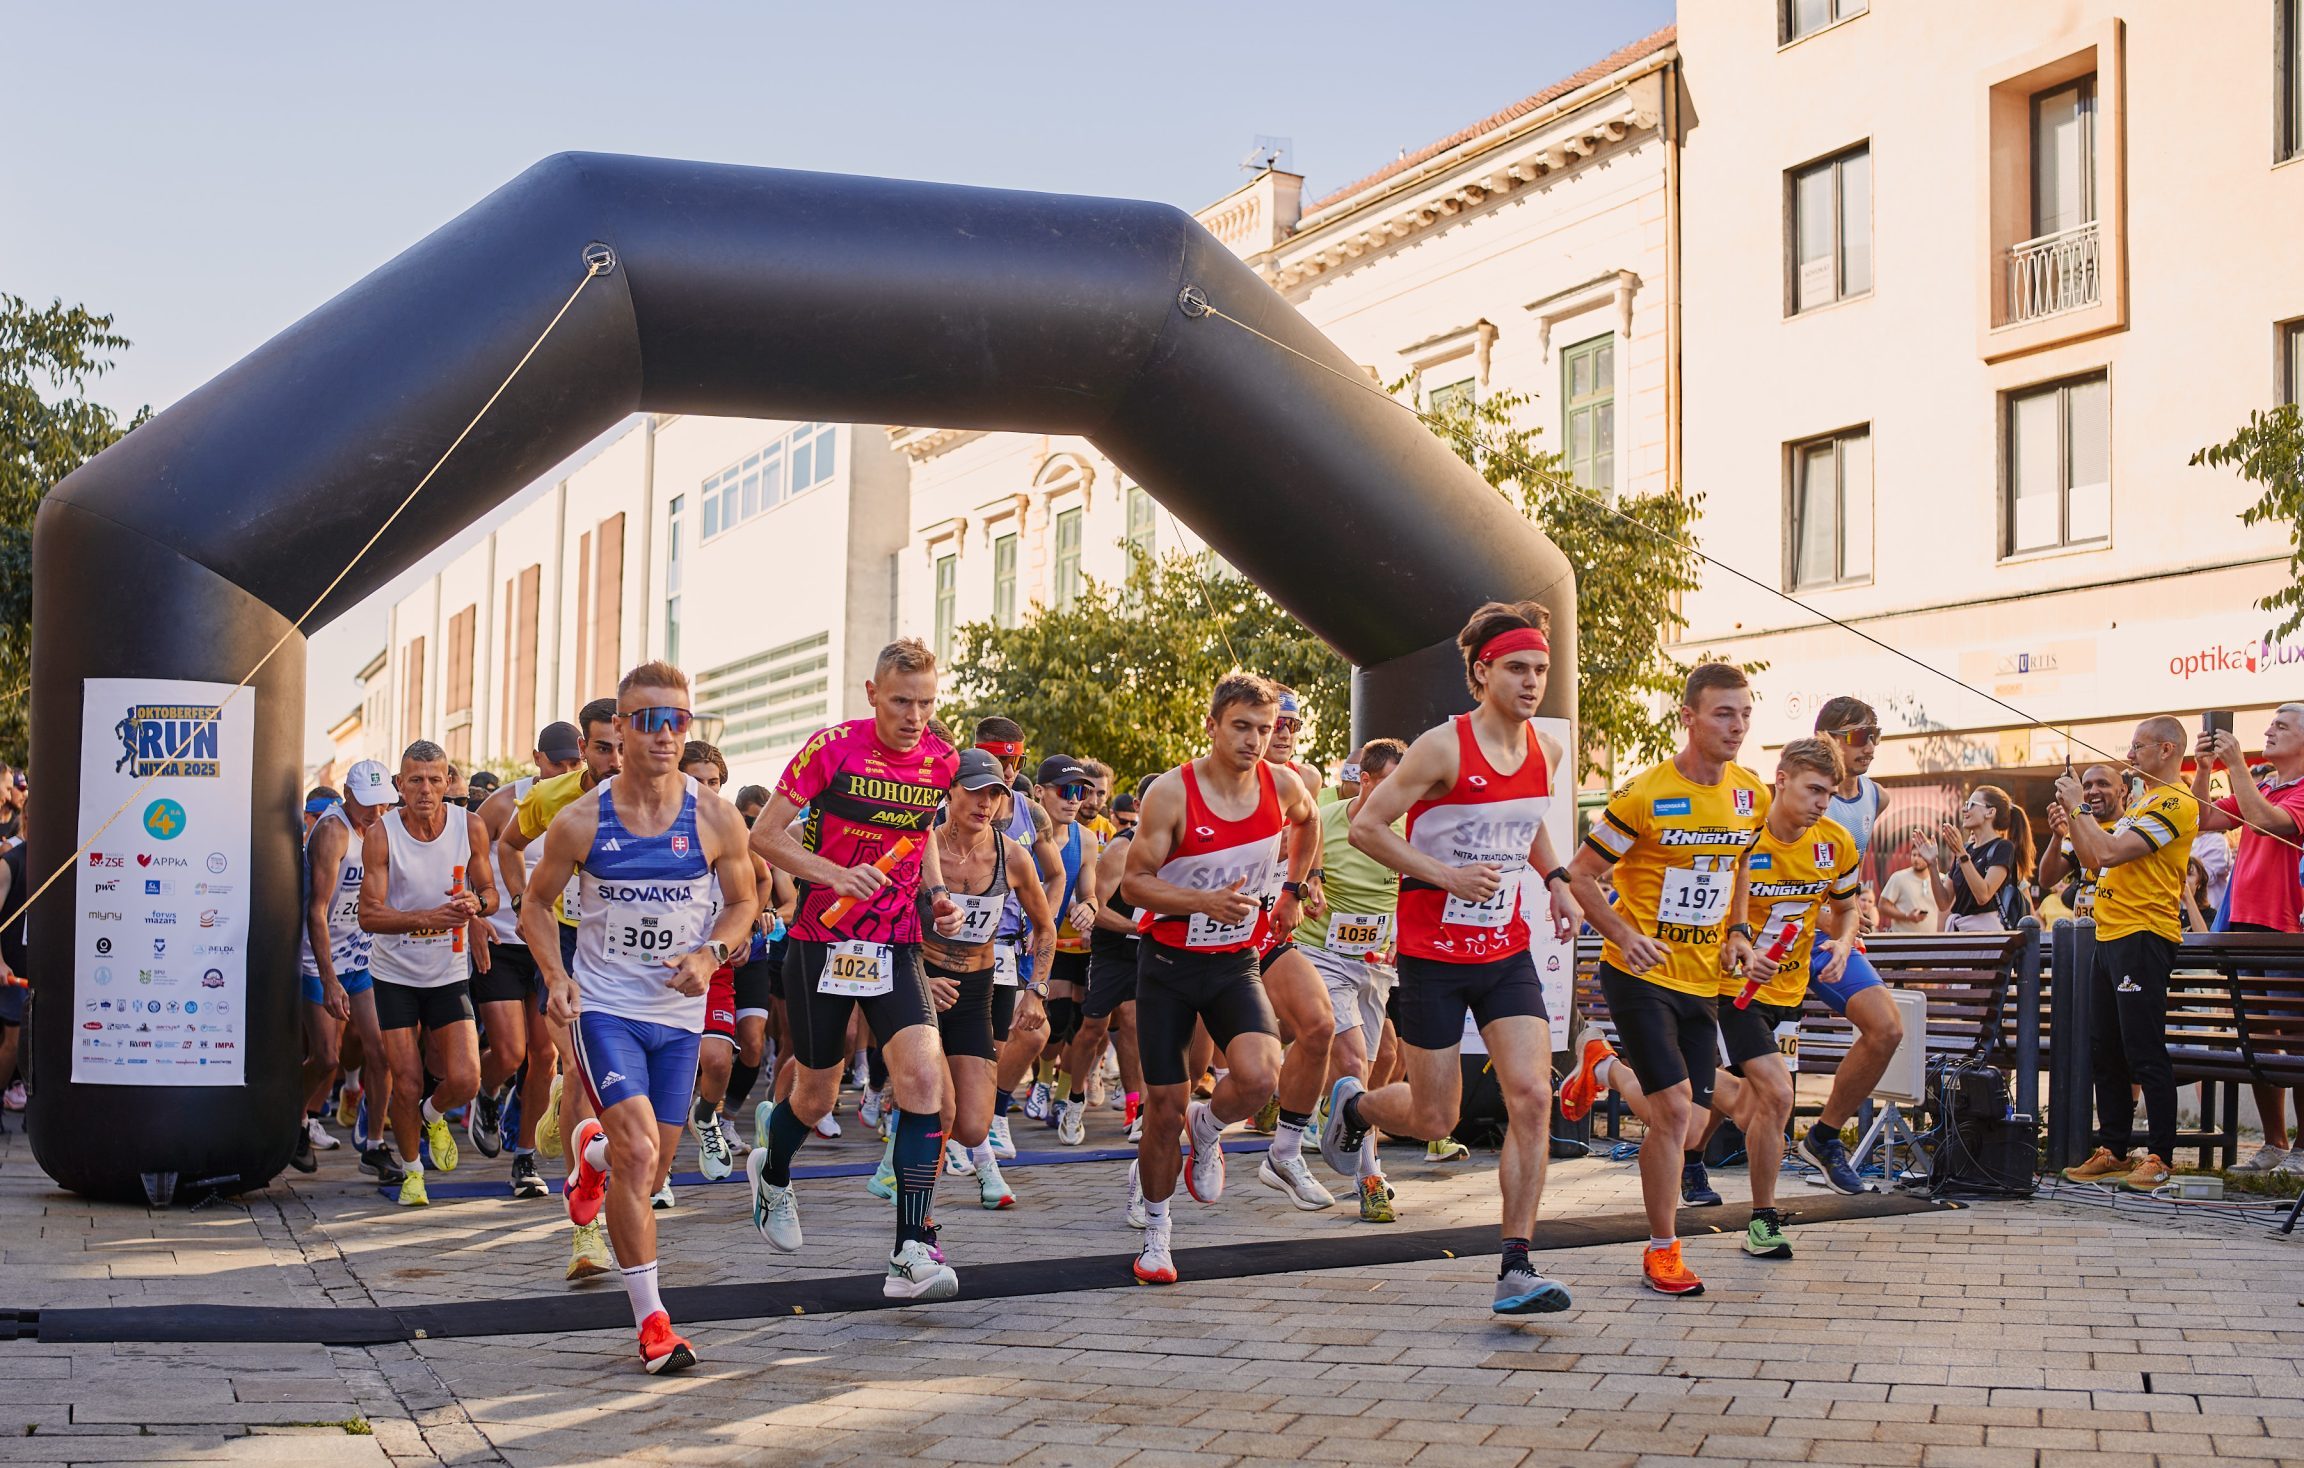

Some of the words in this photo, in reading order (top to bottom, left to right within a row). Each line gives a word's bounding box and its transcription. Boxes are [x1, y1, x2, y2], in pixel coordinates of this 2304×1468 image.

[2169, 645, 2243, 680] optika
[137, 706, 220, 720] OKTOBERFEST
[138, 721, 218, 759] RUN
[139, 764, 180, 776] NITRA
[184, 764, 216, 776] 2025
[847, 774, 944, 807] ROHOZEC
[871, 808, 925, 830] AMIX
[1660, 829, 1752, 845] KNIGHTS
[104, 857, 125, 868] ZSE
[1453, 849, 1479, 861] NITRA
[1480, 853, 1513, 862] TRIATLON
[95, 882, 116, 893] pwc
[598, 884, 694, 903] SLOVAKIA
[1678, 886, 1720, 909] 197
[88, 910, 122, 921] mlyny
[152, 910, 177, 918] forvis
[623, 926, 673, 950] 309
[1338, 926, 1378, 942] 1036
[1653, 921, 1719, 945] Forbes
[833, 957, 879, 979] 1024
